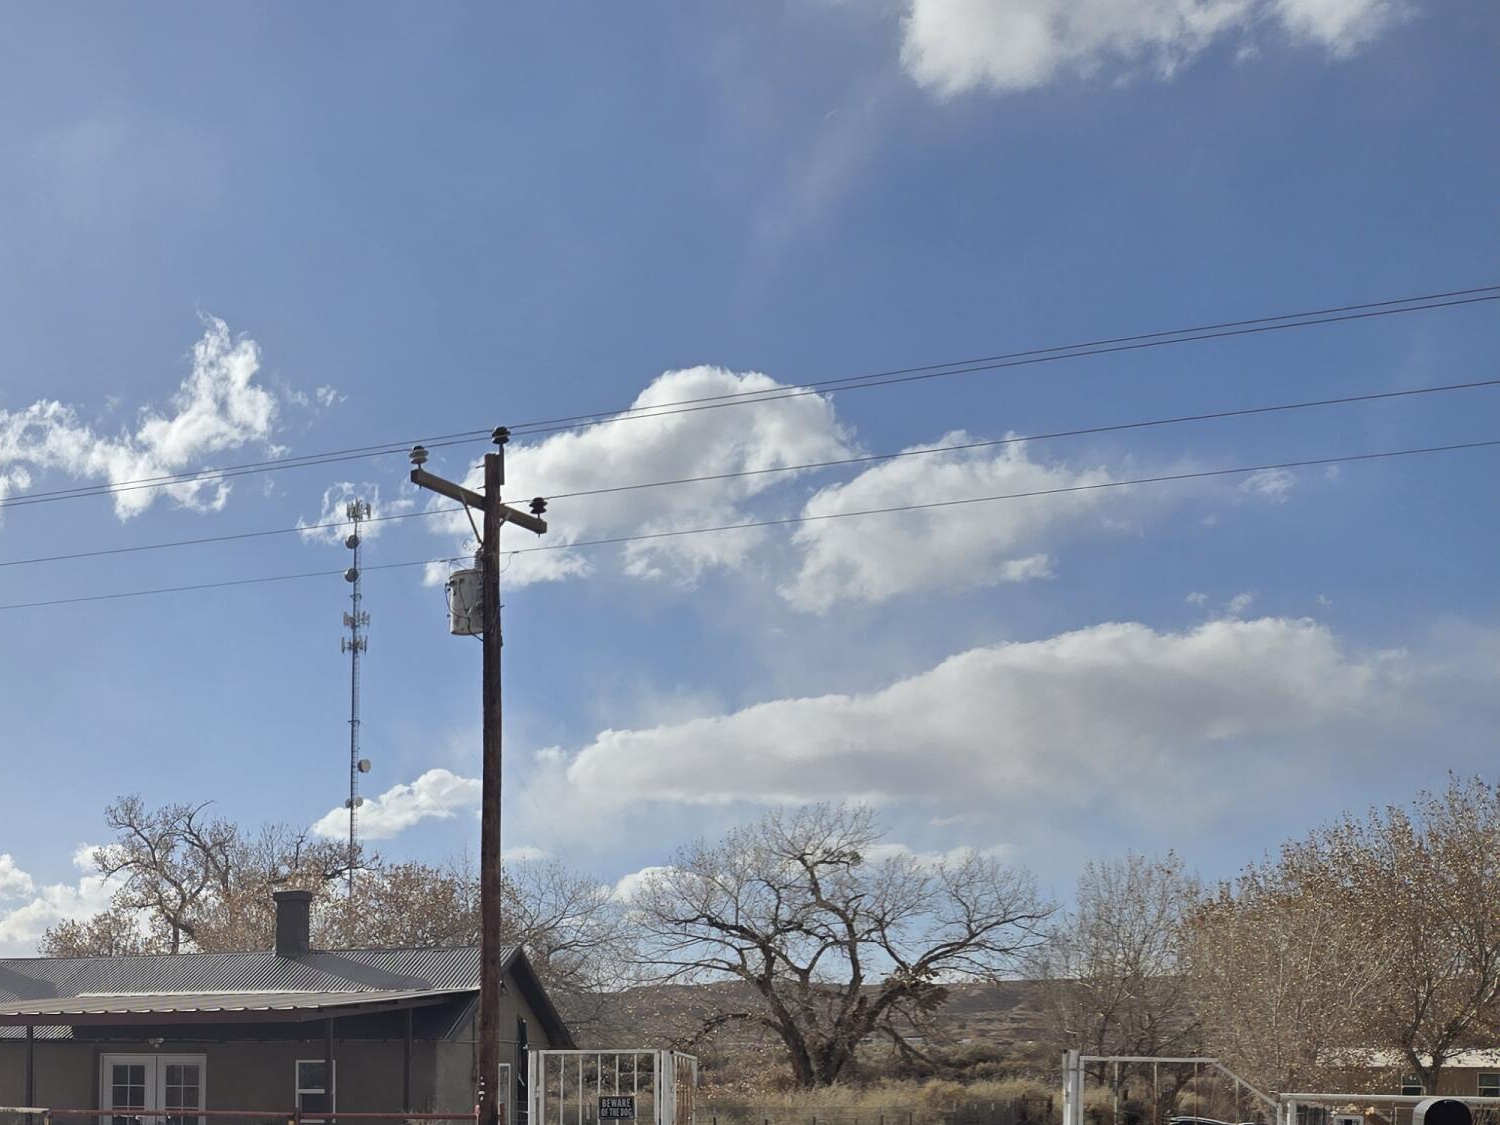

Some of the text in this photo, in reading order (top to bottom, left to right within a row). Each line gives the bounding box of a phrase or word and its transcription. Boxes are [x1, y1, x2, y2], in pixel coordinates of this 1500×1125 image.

[602, 1098, 631, 1108] BEWARE
[601, 1108, 633, 1117] OF THE DOG
